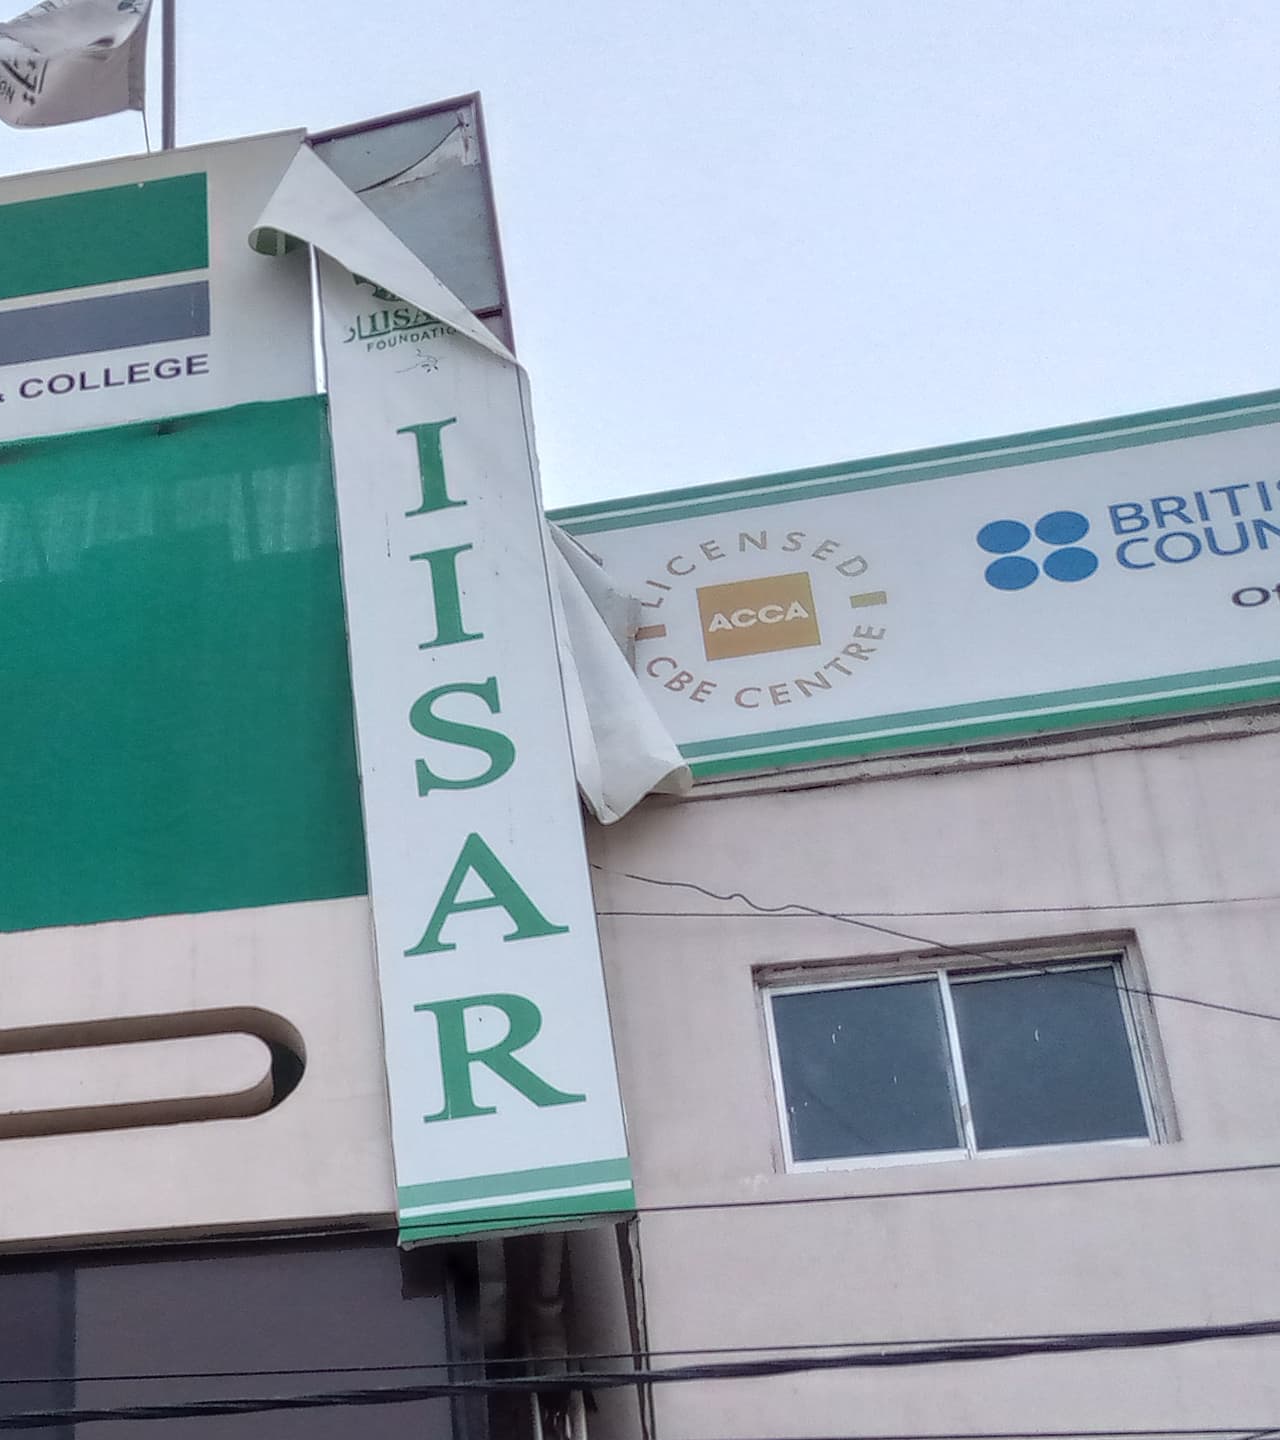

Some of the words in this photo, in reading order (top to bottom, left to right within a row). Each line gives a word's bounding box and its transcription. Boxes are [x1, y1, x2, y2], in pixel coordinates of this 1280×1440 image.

[366, 326, 458, 352] FOUNDATIO
[369, 308, 440, 333] IISA
[19, 353, 210, 400] COLLEGE
[1107, 479, 1280, 536] BRITI
[640, 530, 869, 610] LICENSED
[708, 600, 810, 634] ACCA
[646, 655, 717, 704] CBE
[734, 624, 888, 709] CENTRE
